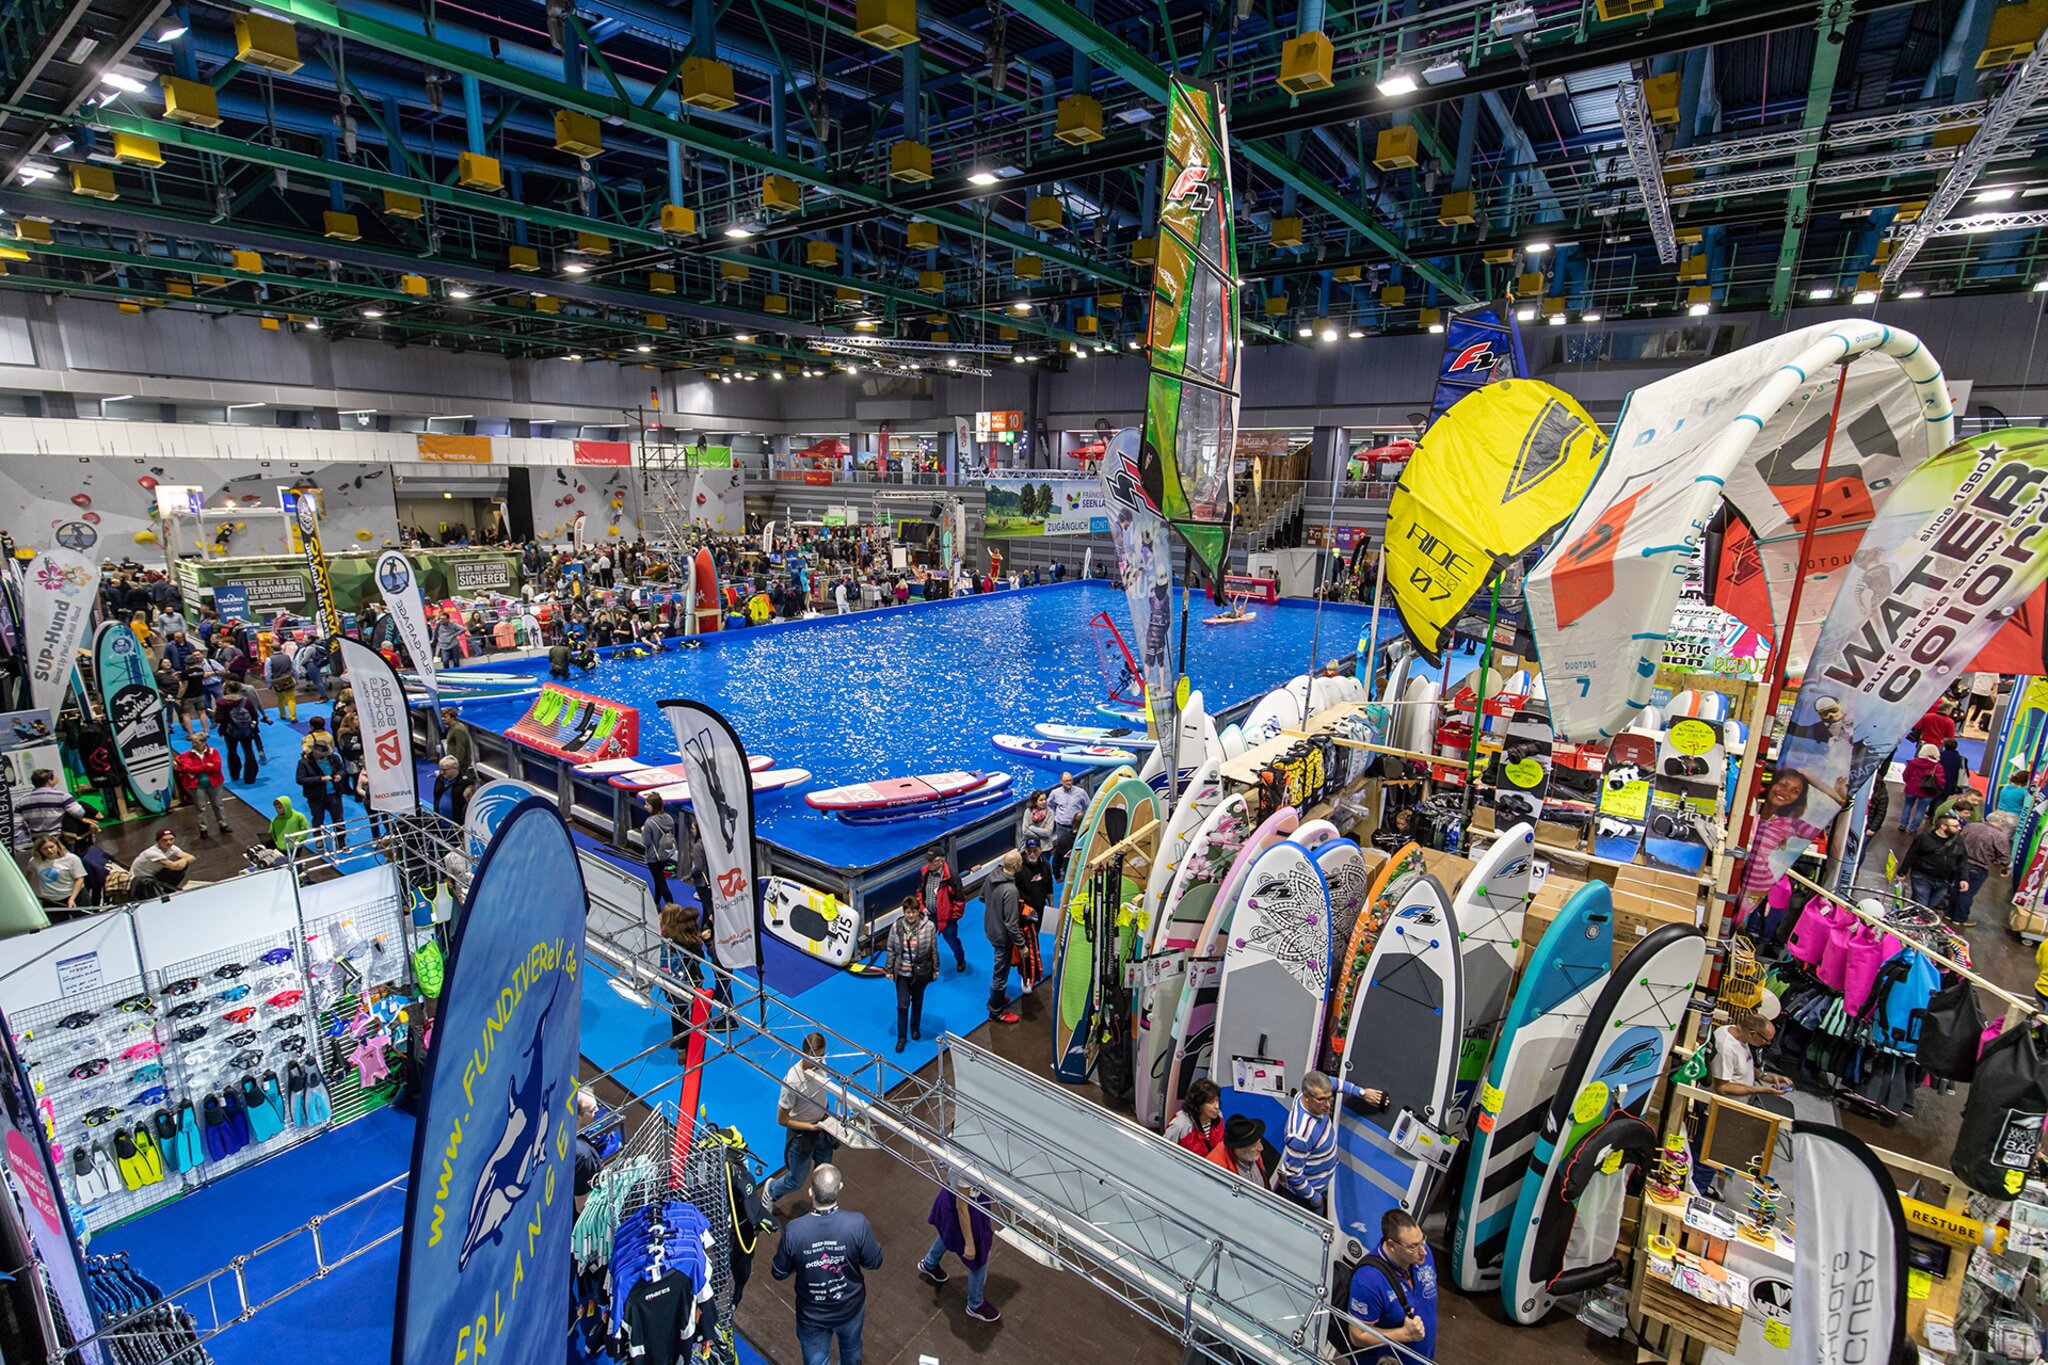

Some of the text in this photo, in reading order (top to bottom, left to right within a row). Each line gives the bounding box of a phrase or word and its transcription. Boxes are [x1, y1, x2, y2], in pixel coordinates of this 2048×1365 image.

[1448, 341, 1500, 373] F2
[1008, 414, 1019, 429] 10
[1920, 461, 1991, 542] since 1990
[1047, 521, 1088, 532] ZUGÄNGLICH
[1092, 520, 1108, 529] KONT
[1406, 522, 1474, 582] RIDE
[258, 578, 276, 586] GEHT
[287, 577, 301, 585] UMS
[459, 574, 506, 587] SICHERER
[1824, 461, 2048, 689] WATER
[1863, 487, 2048, 693] surf skate snow styl
[1674, 608, 1721, 617] NORTH
[34, 599, 70, 682] SUP-Hund
[1565, 660, 1597, 670] DUOTONE
[1576, 675, 1591, 698] 7
[1492, 854, 1533, 880] F2
[1250, 879, 1300, 900] F2
[1396, 904, 1442, 926] F2
[837, 918, 853, 945] 215
[2003, 1140, 2036, 1154] BAG
[1912, 1209, 1976, 1239] RESTUBE
[645, 1286, 670, 1300] mares
